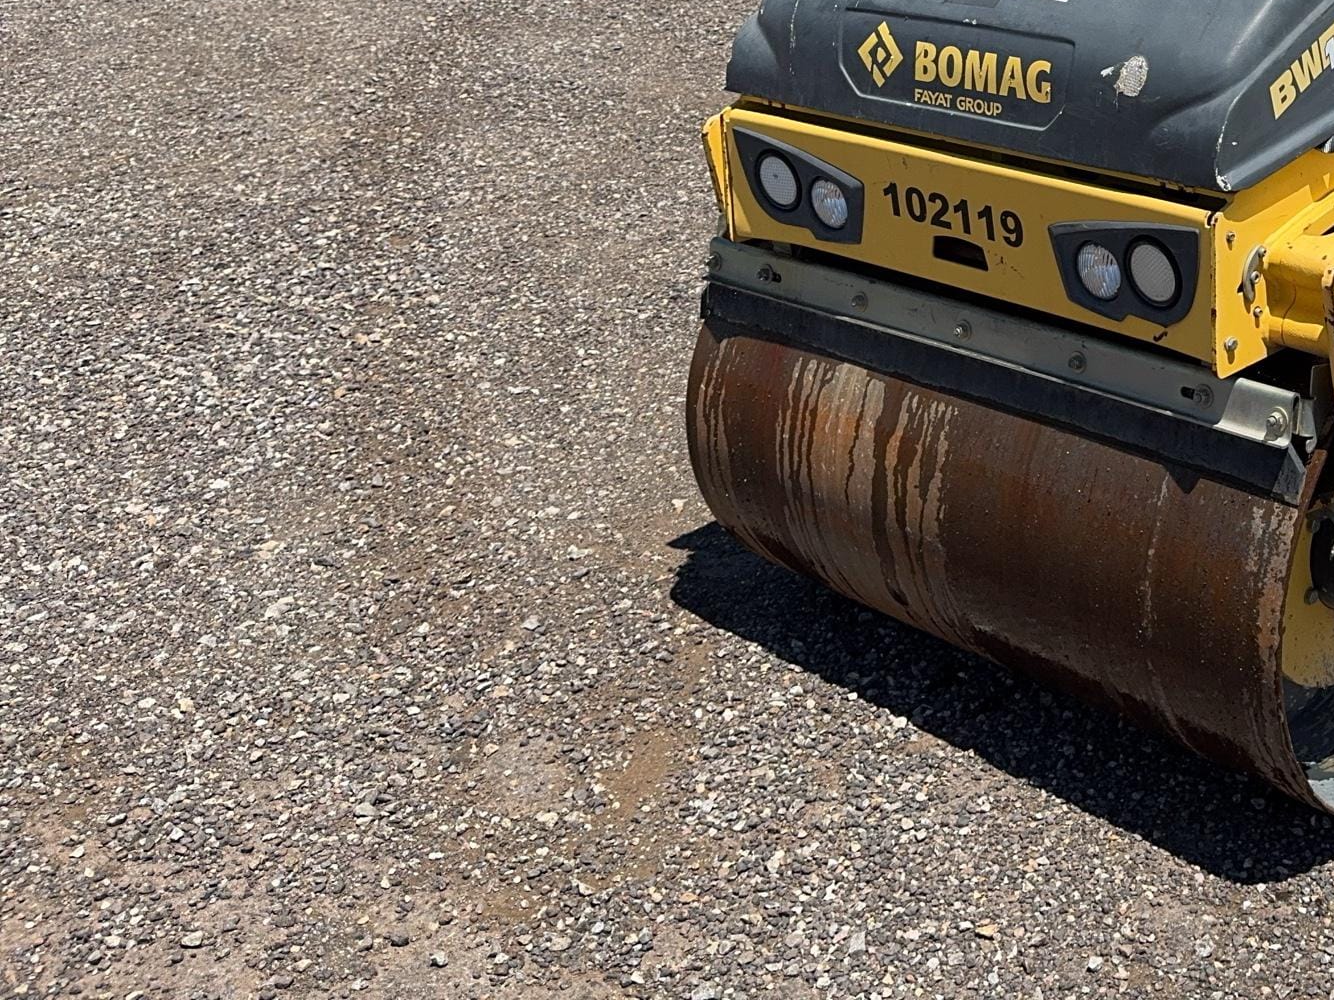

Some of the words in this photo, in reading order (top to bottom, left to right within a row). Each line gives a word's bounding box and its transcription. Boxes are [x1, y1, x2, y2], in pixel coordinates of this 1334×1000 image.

[913, 88, 953, 109] FAYAT
[956, 96, 1002, 117] GROUP
[914, 40, 1052, 104] BOMAG
[882, 182, 1024, 249] 102119
